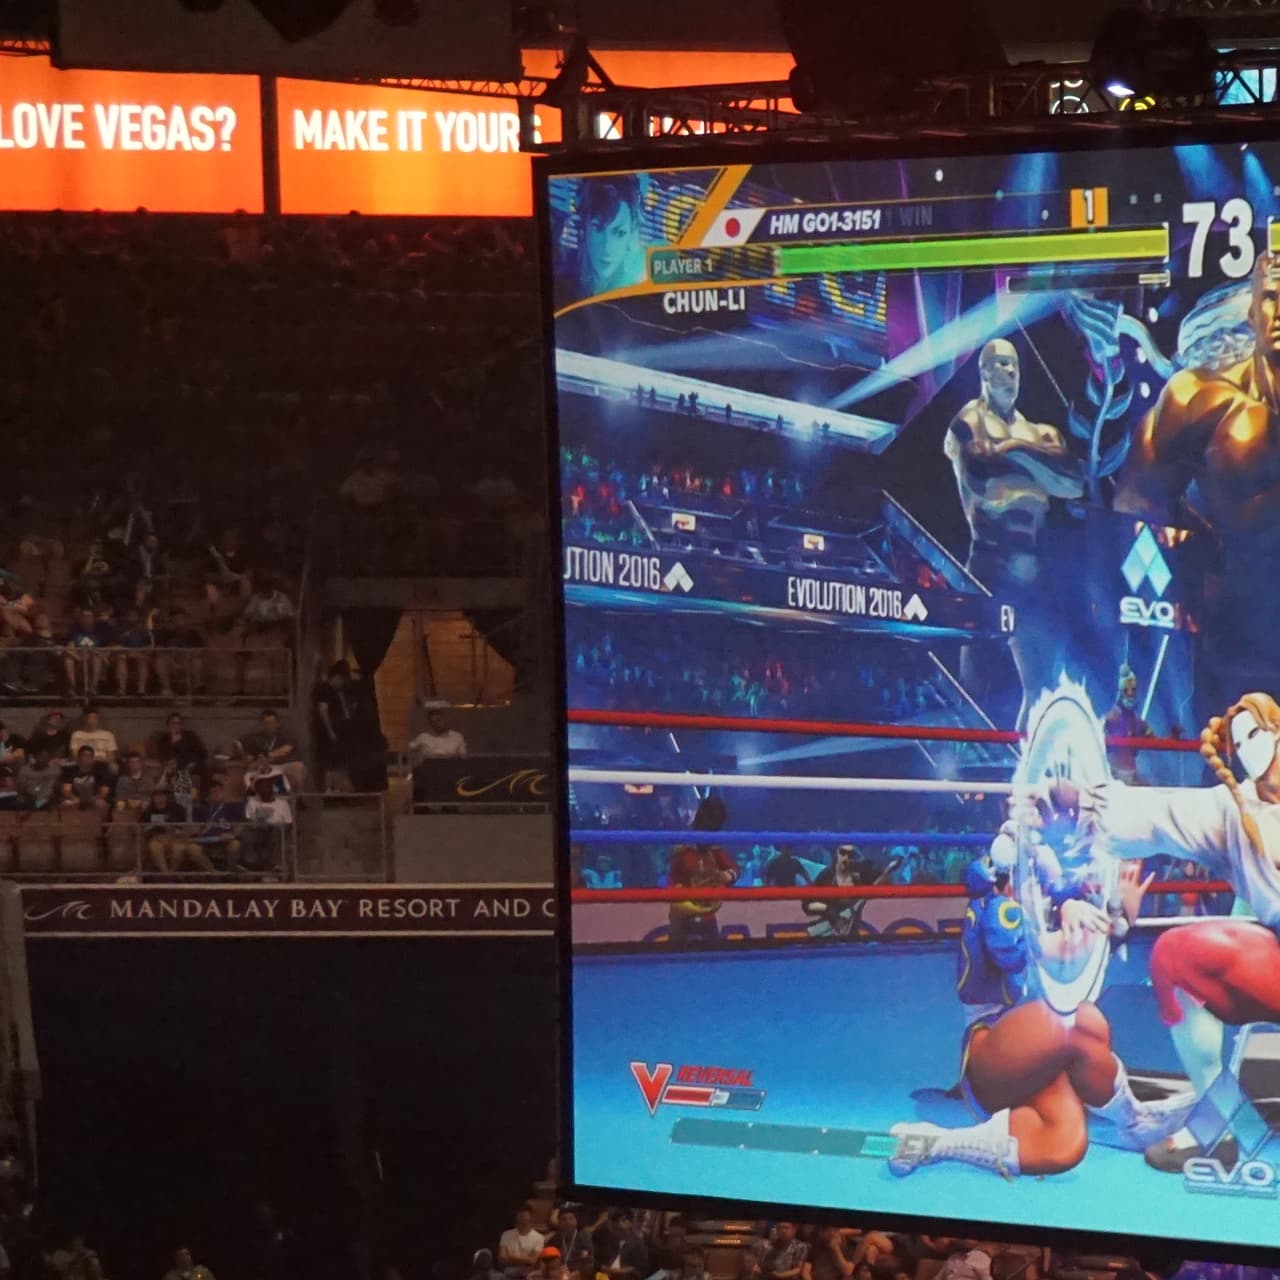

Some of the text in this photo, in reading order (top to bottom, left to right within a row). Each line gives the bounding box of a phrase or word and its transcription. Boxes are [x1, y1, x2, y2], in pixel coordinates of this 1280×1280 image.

[94, 105, 237, 151] VEGAS?
[295, 109, 388, 152] MAKE
[397, 110, 426, 152] IT
[1083, 189, 1096, 224] 1
[769, 213, 800, 236] HM
[1182, 197, 1255, 279] 73
[654, 258, 701, 275] PLAYER
[663, 288, 746, 314] CHUN-LI
[619, 553, 661, 591] 2016
[788, 576, 902, 619] EVOLUTION 2016
[1120, 596, 1175, 623] EVO
[109, 898, 280, 919] MANDALAY
[290, 898, 343, 919] BAY
[359, 898, 461, 919] RESORT
[473, 898, 531, 919] AND
[630, 1061, 755, 1117] V REVERSAL
[1183, 1156, 1276, 1187] EVO
